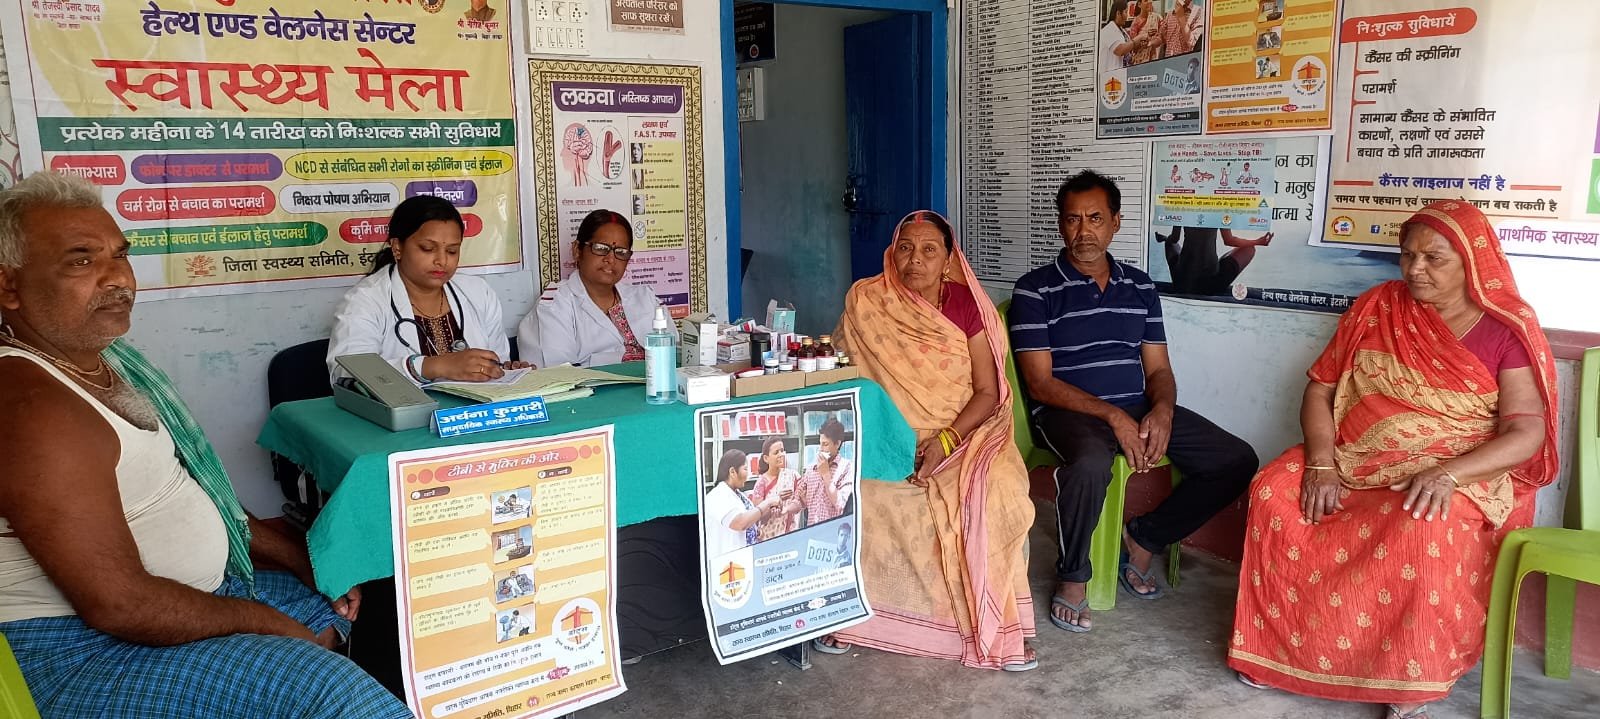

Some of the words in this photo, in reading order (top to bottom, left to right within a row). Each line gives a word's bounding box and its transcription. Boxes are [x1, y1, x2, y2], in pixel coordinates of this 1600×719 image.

[669, 0, 678, 11] को
[140, 2, 200, 36] हेल्थ
[204, 13, 257, 39] एण्ड
[262, 7, 349, 42] वेलनेस
[353, 12, 416, 44] सेन्टर
[621, 11, 637, 20] साफ
[1408, 13, 1456, 36] सुविधायें
[1365, 49, 1392, 64] कैंसर
[1396, 48, 1411, 62] की
[1416, 45, 1461, 61] स्क्रीनिंग
[91, 59, 335, 112] स्वास्थ्य
[344, 47, 470, 112] मेला
[1164, 72, 1185, 89] DOTS
[1362, 79, 1397, 94] परामर्श
[559, 87, 615, 106] लकवा
[1359, 112, 1397, 124] सामान्य
[1400, 108, 1429, 123] कैंसर
[1433, 108, 1446, 123] के
[1449, 107, 1497, 122] संभावित
[59, 122, 125, 143] प्रत्येक
[129, 122, 191, 141] महीना
[194, 123, 215, 140] के
[219, 122, 245, 140] 14
[250, 122, 305, 140] तारीख
[309, 121, 334, 139] को
[408, 121, 441, 139] सभी
[444, 122, 501, 145] सुविधायें
[1399, 126, 1430, 141] लक्षणों
[1434, 125, 1451, 141] एवं
[1454, 125, 1485, 140] उससे
[1357, 147, 1384, 159] बचाव
[1387, 143, 1400, 159] के
[1403, 144, 1424, 159] प्रति
[1426, 147, 1485, 159] जागरूकता
[221, 162, 232, 177] से
[295, 162, 317, 174] NCD
[321, 160, 329, 174] से
[331, 158, 366, 173] संबंधित
[368, 158, 388, 172] सभी
[412, 160, 424, 171] का
[464, 157, 477, 172] एवं
[479, 156, 503, 170] ईलाज
[1296, 154, 1315, 168] का
[1378, 172, 1409, 189] कैंसर
[1412, 175, 1464, 190] लाइलाज
[1468, 174, 1493, 191] नहीं
[1495, 174, 1506, 191] है
[123, 196, 143, 213] चर्म
[146, 196, 166, 212] रोग
[168, 196, 179, 212] से
[181, 197, 209, 211] बचाव
[212, 197, 227, 209] का
[229, 193, 265, 210] परामर्श
[292, 191, 322, 207] निक्षय
[323, 191, 350, 206] पोषण
[352, 189, 391, 205] अभियान
[1334, 194, 1356, 204] समय
[1358, 194, 1370, 205] पर
[1372, 195, 1402, 206] पहचान
[1404, 196, 1419, 207] एवं
[1494, 199, 1510, 210] बच
[1514, 198, 1545, 211] सकती
[1549, 198, 1558, 211] है
[157, 230, 169, 246] से
[169, 233, 199, 246] बचाव
[202, 228, 216, 244] एवं
[220, 228, 251, 244] ईलाज
[254, 227, 271, 246] हेतु
[272, 224, 308, 240] परामर्श
[351, 221, 372, 240] कृमि
[1499, 226, 1548, 243] प्राथमिक
[1552, 231, 1599, 246] स्वास्थ्य
[223, 256, 257, 273] जिला
[440, 409, 488, 424] अर्चना
[493, 401, 542, 418] कुमारी
[448, 464, 473, 477] टीबी
[475, 462, 486, 473] से
[488, 458, 517, 474] मुक्ति
[520, 454, 536, 466] की
[807, 545, 834, 563] DOTS
